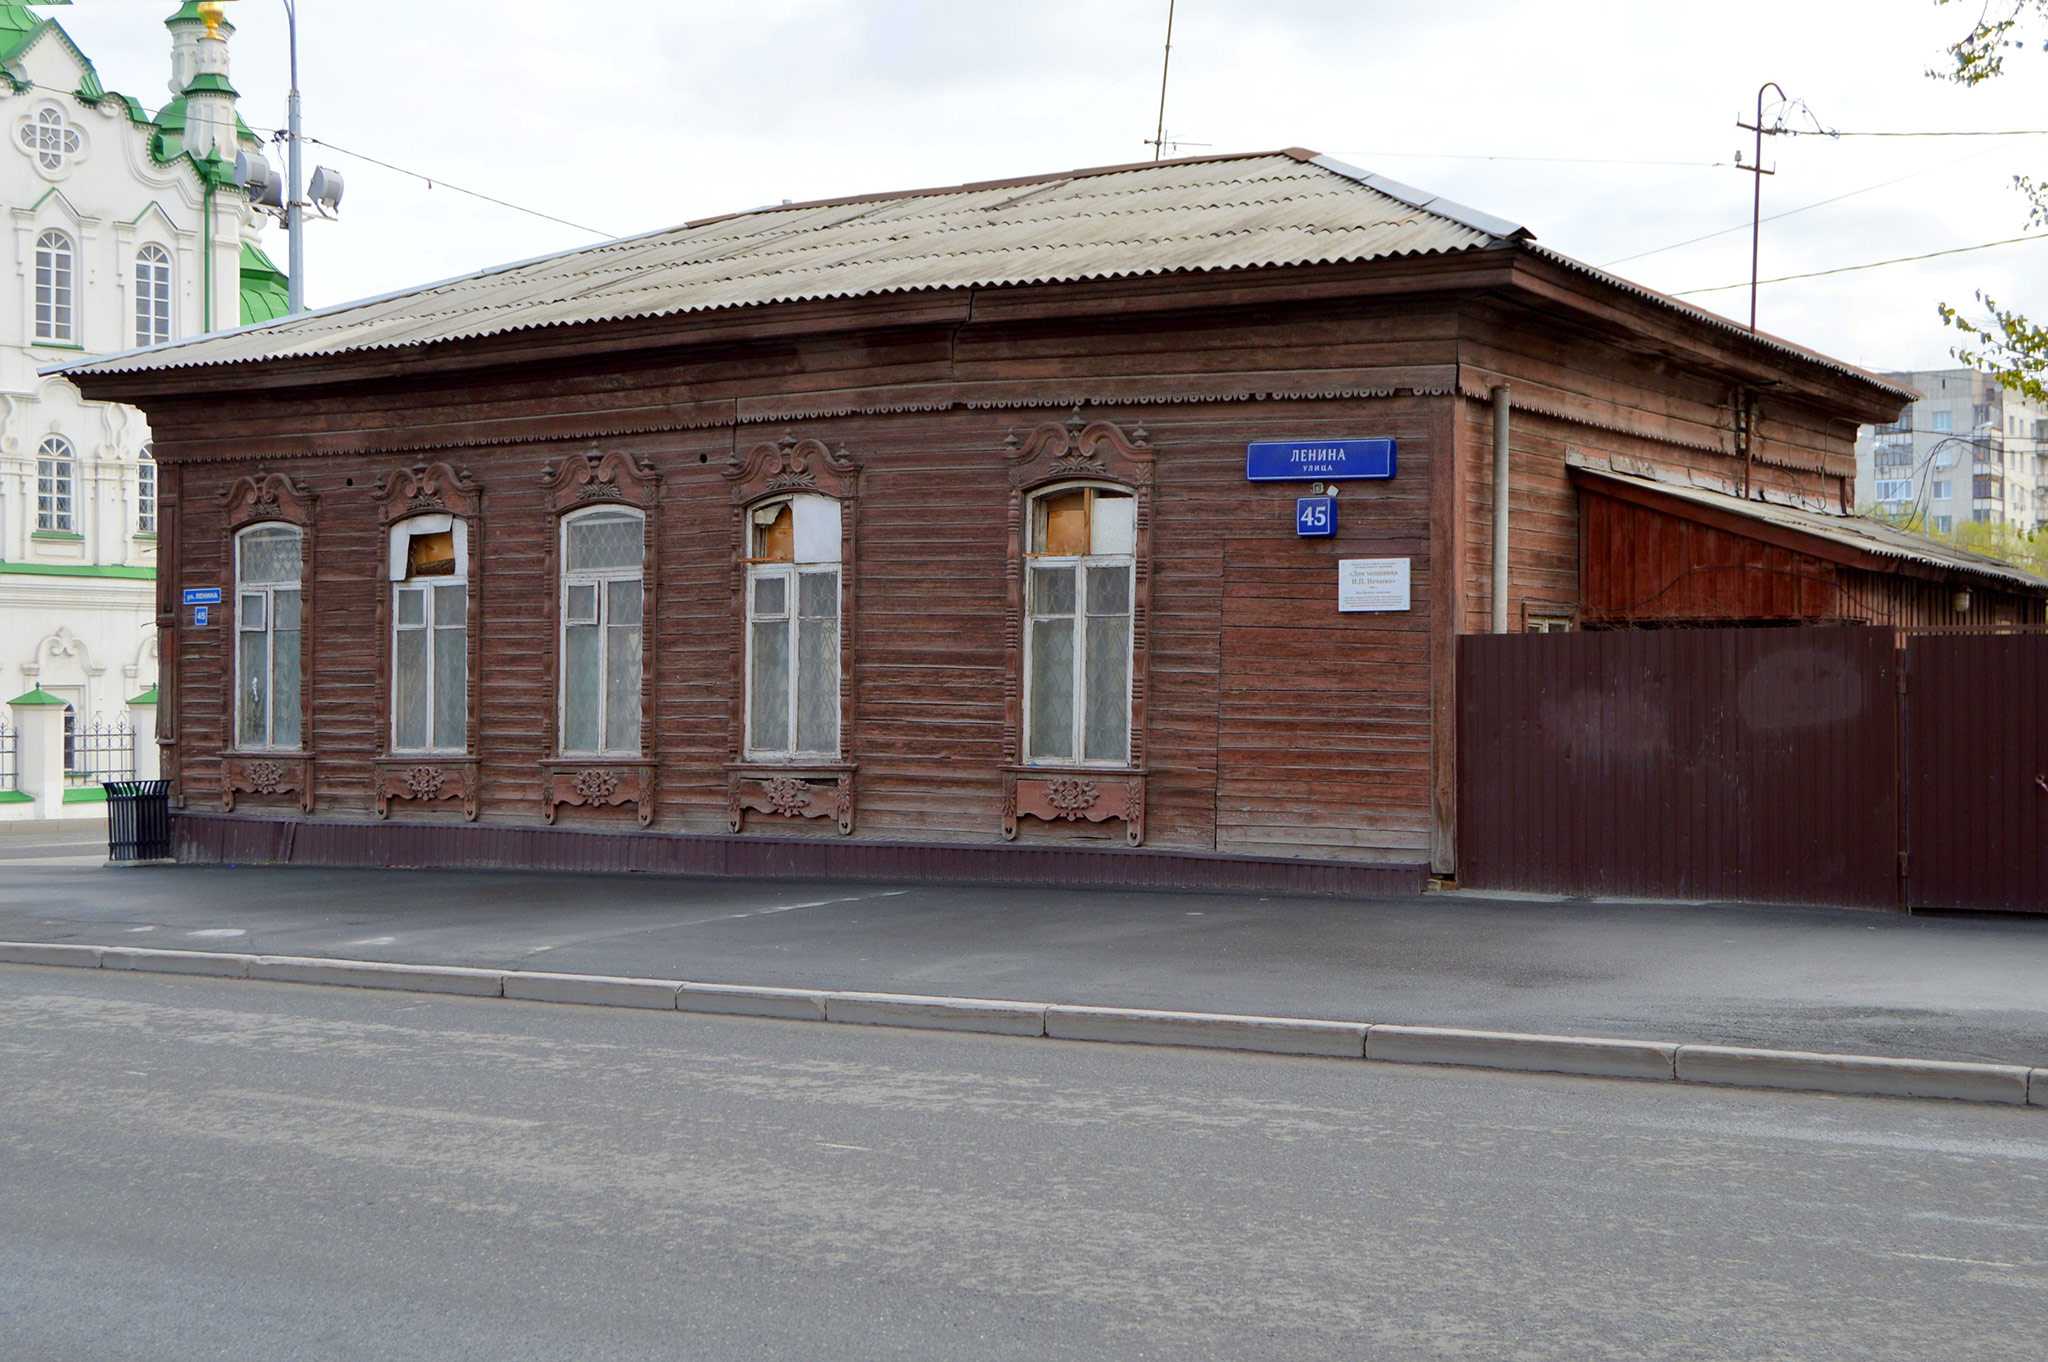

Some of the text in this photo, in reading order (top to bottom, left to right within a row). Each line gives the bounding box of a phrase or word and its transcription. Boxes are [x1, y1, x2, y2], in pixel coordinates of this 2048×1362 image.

[1290, 448, 1346, 462] ЛЕНИНА
[1303, 464, 1333, 472] УЛИЦА
[1300, 506, 1327, 526] 45
[196, 611, 206, 620] 45
